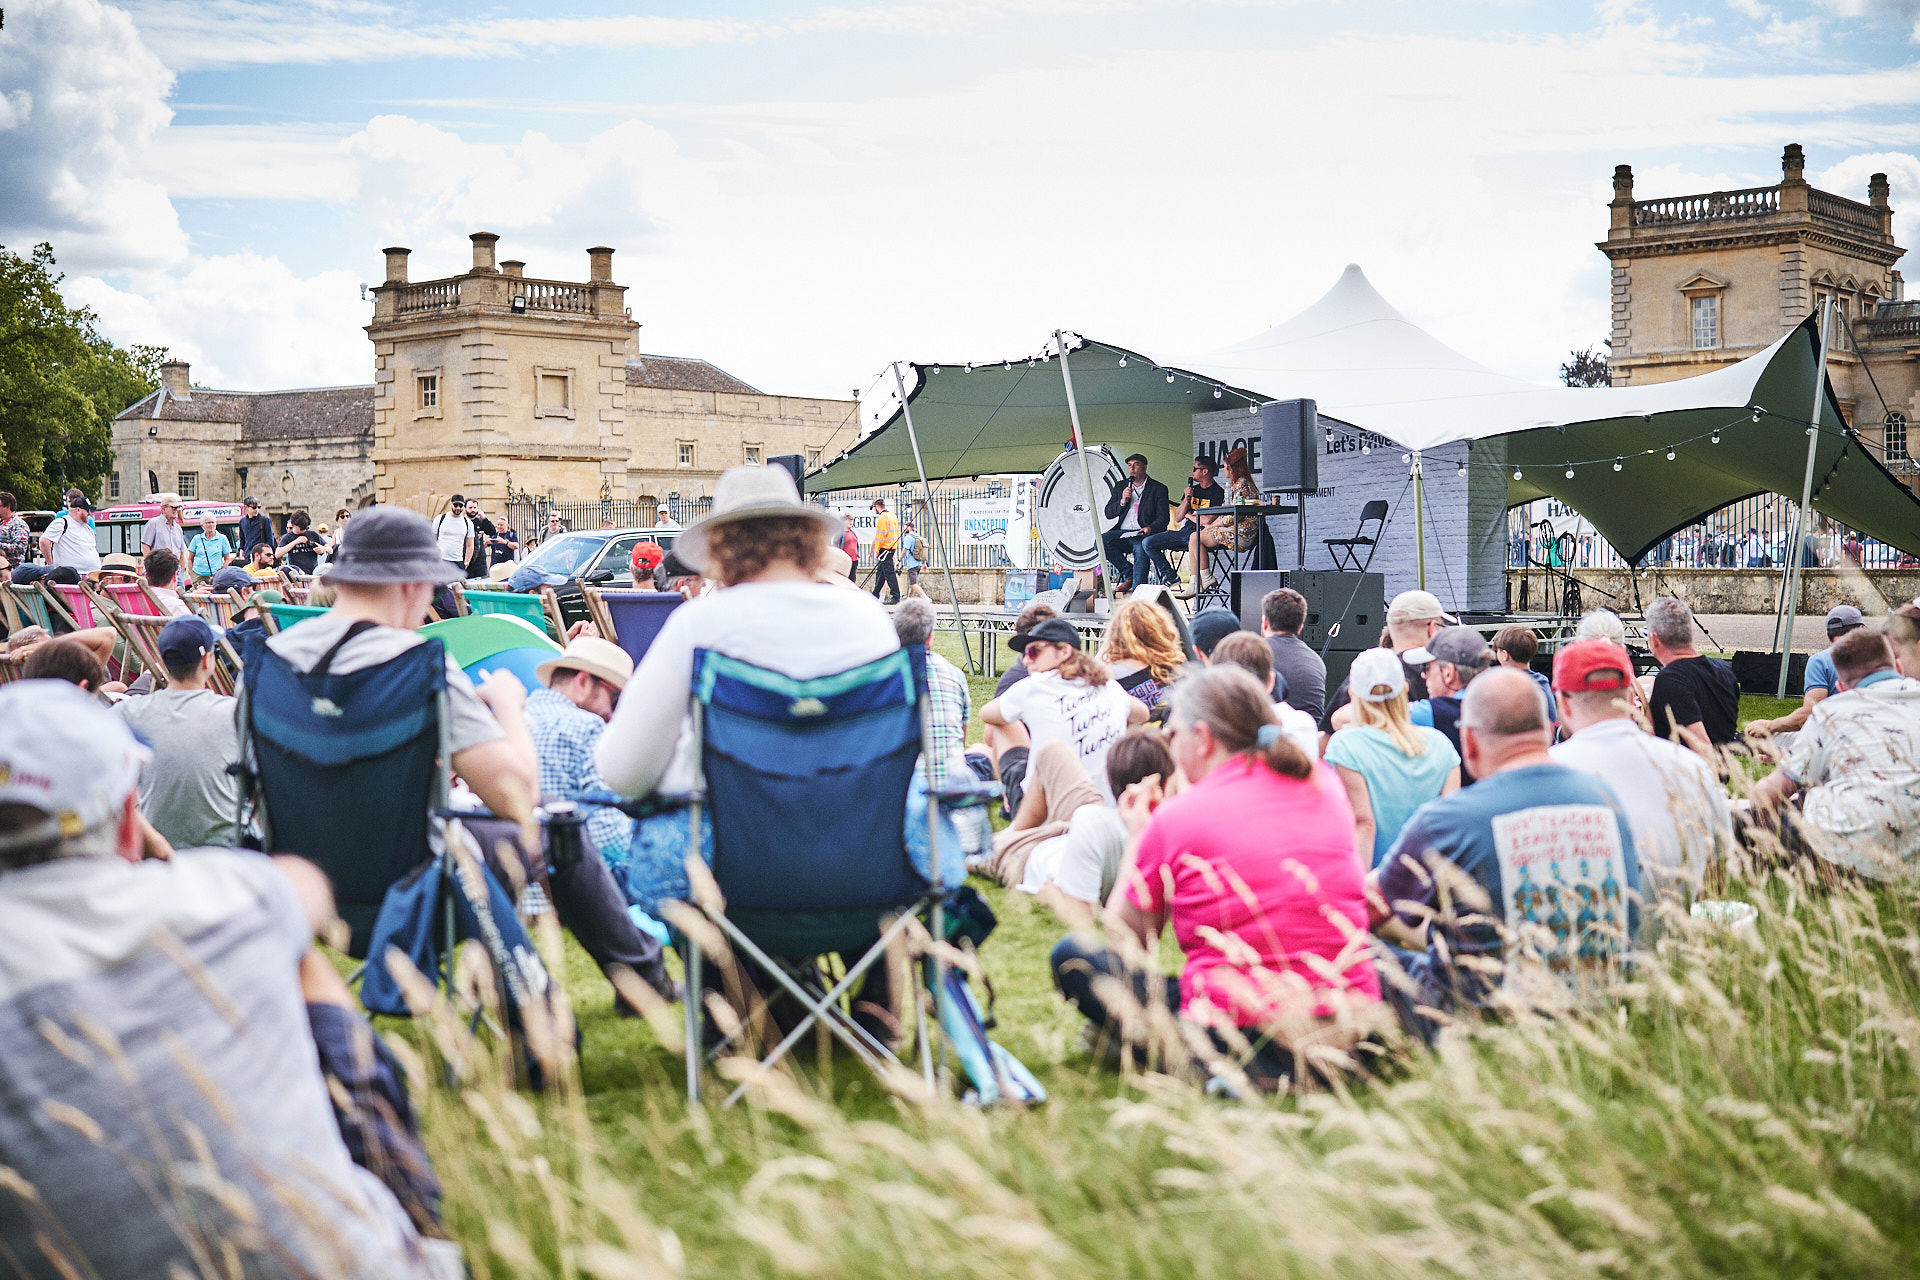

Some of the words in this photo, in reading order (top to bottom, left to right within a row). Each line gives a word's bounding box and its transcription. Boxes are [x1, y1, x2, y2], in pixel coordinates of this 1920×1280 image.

[1326, 435, 1356, 454] Let's
[964, 518, 1008, 531] UNEXCEPTIO
[1066, 707, 1111, 736] Turbo
[1074, 725, 1120, 758] Turbo
